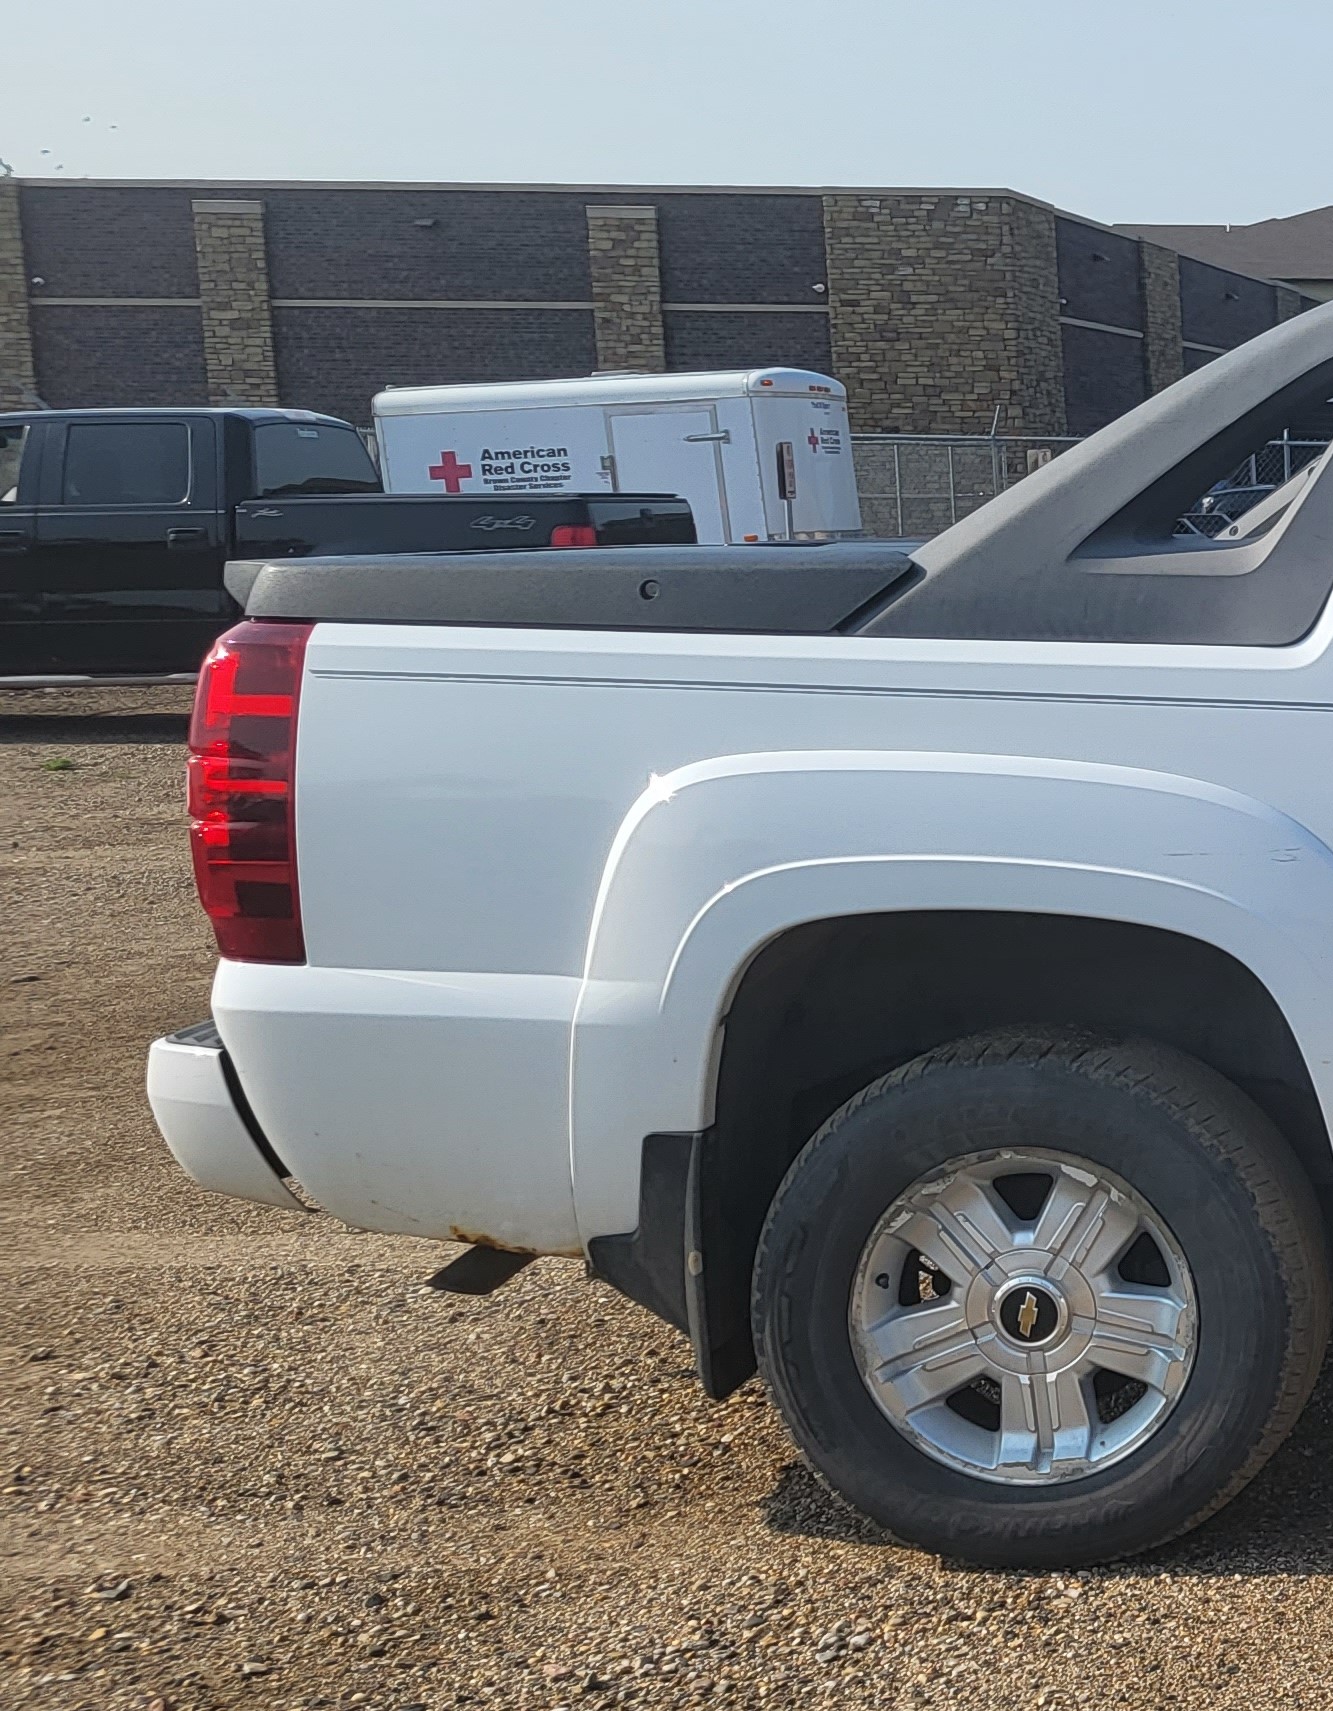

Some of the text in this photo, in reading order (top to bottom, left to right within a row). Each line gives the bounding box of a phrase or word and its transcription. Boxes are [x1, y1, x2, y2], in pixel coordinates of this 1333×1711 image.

[480, 446, 568, 461] American
[480, 461, 571, 476] Red Cross
